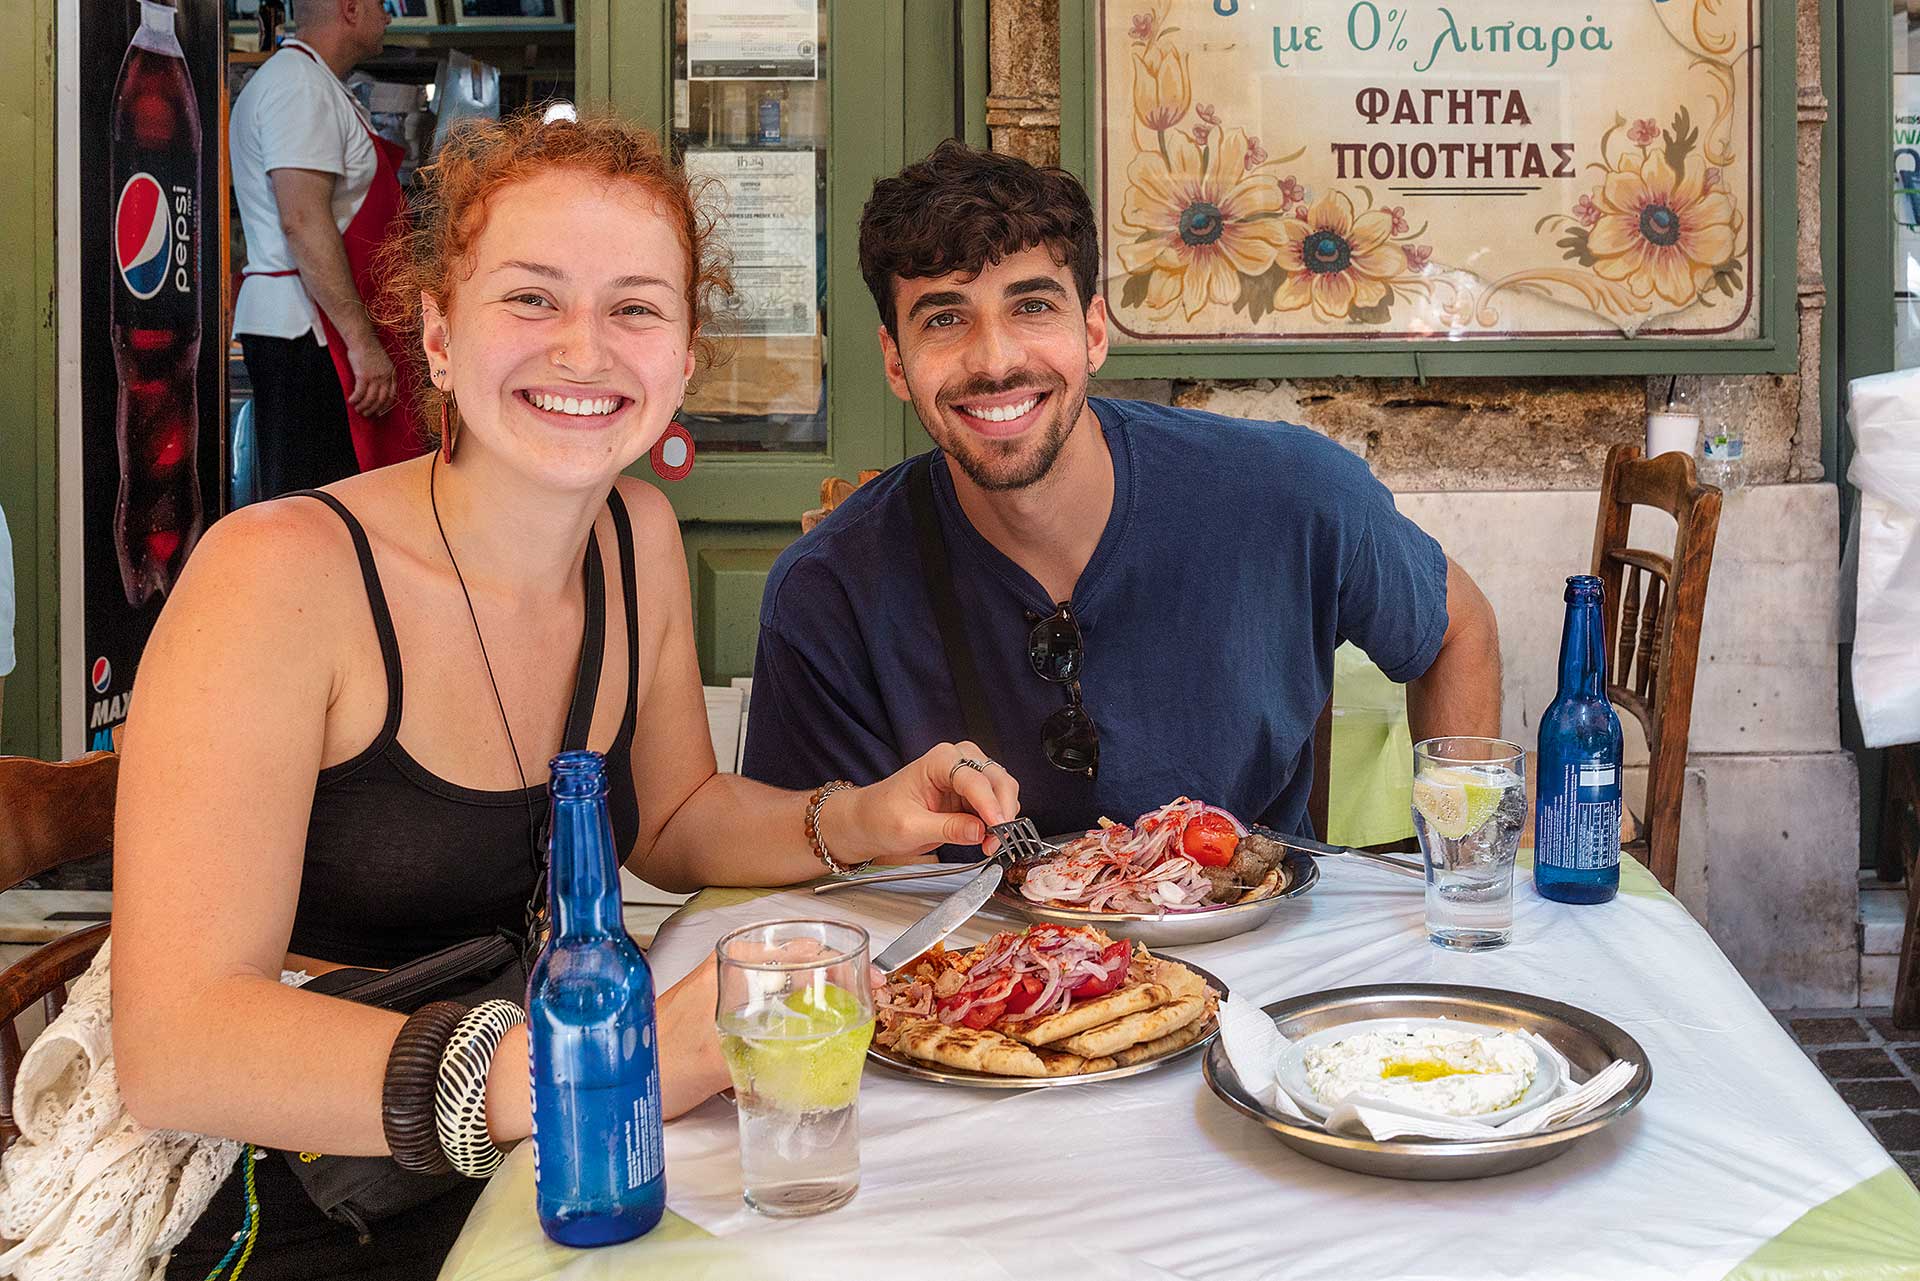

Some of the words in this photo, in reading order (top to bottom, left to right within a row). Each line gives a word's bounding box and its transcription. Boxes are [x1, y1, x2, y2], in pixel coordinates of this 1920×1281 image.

[1273, 26, 1323, 68] με
[1347, 1, 1408, 51] 0%
[1413, 7, 1613, 72] λιπαρά
[1355, 87, 1532, 125] ΦΑΓΗΤΑ
[1331, 142, 1576, 180] ΠΟΙΟΤΗΤΑΣ
[172, 185, 190, 293] pepsi
